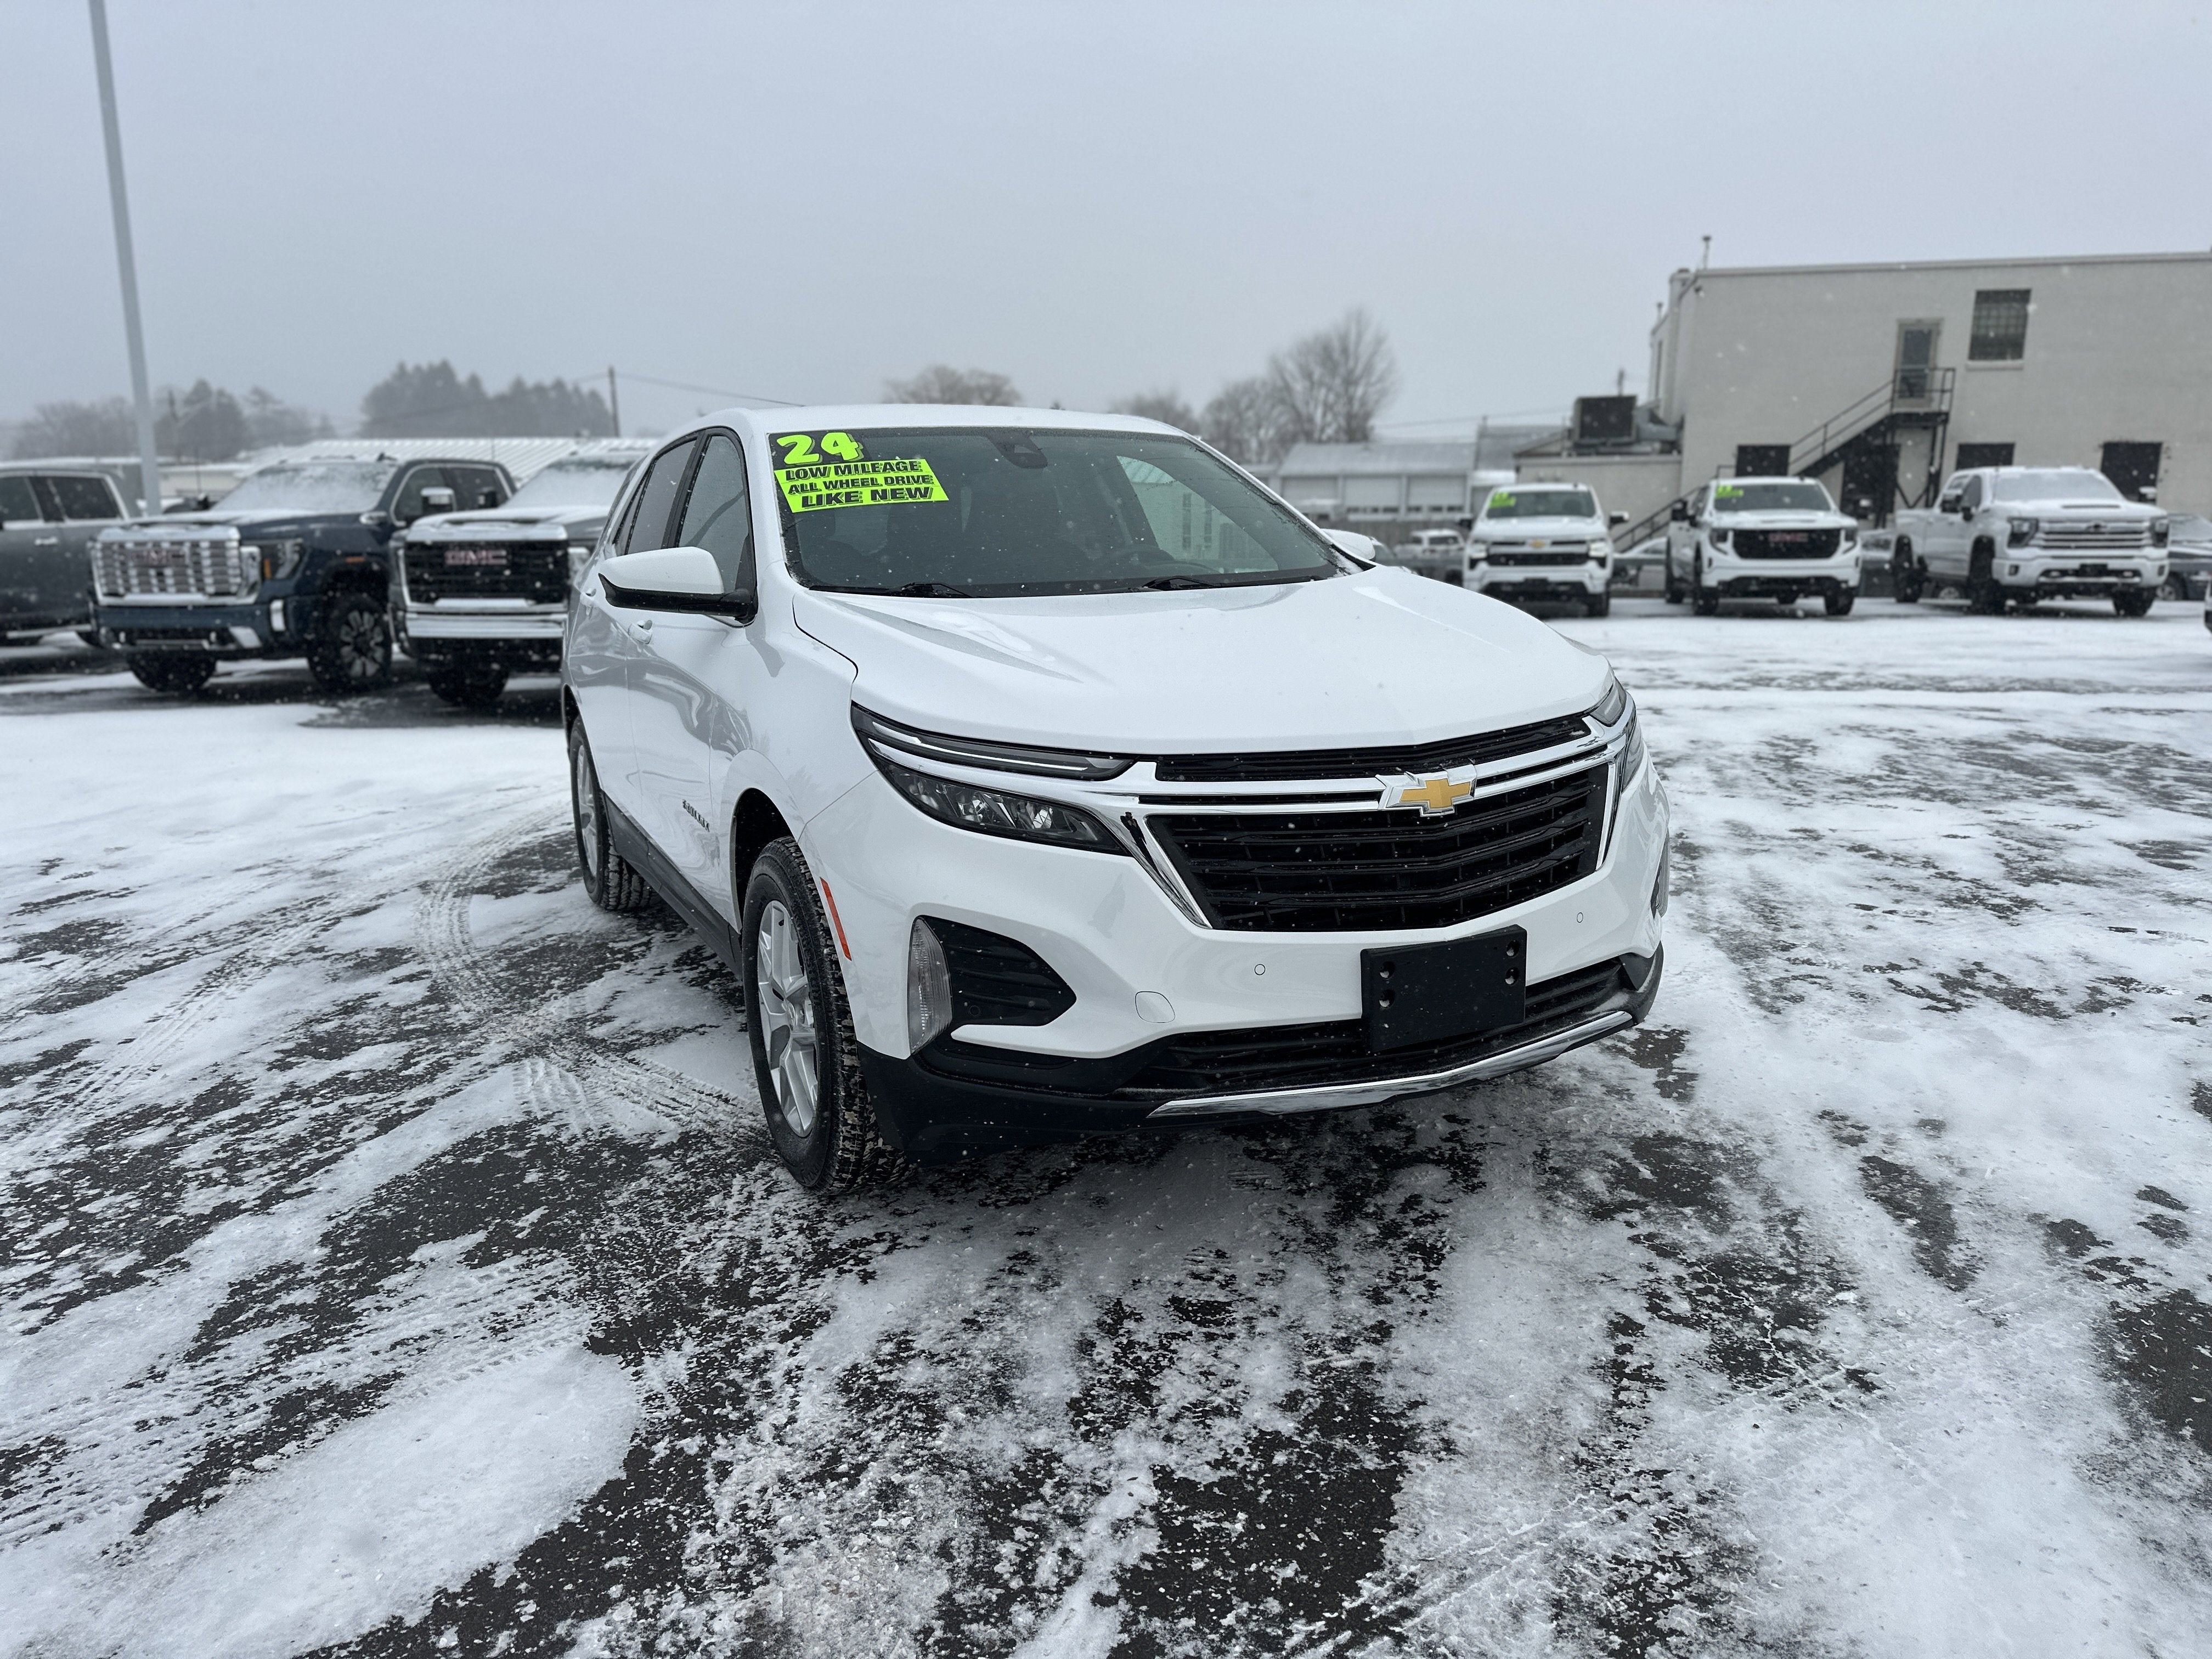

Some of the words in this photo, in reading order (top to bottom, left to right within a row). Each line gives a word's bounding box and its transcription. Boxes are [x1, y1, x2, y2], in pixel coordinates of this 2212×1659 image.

[776, 432, 864, 464] 24
[786, 466, 831, 481] LOW
[834, 460, 922, 476] MILEAGE
[788, 482, 822, 494] ALL
[823, 477, 881, 490] WHEEL
[884, 474, 934, 487] DRIVE
[802, 490, 864, 509] LIKE
[871, 486, 933, 502] NEW
[445, 549, 507, 565] GMC
